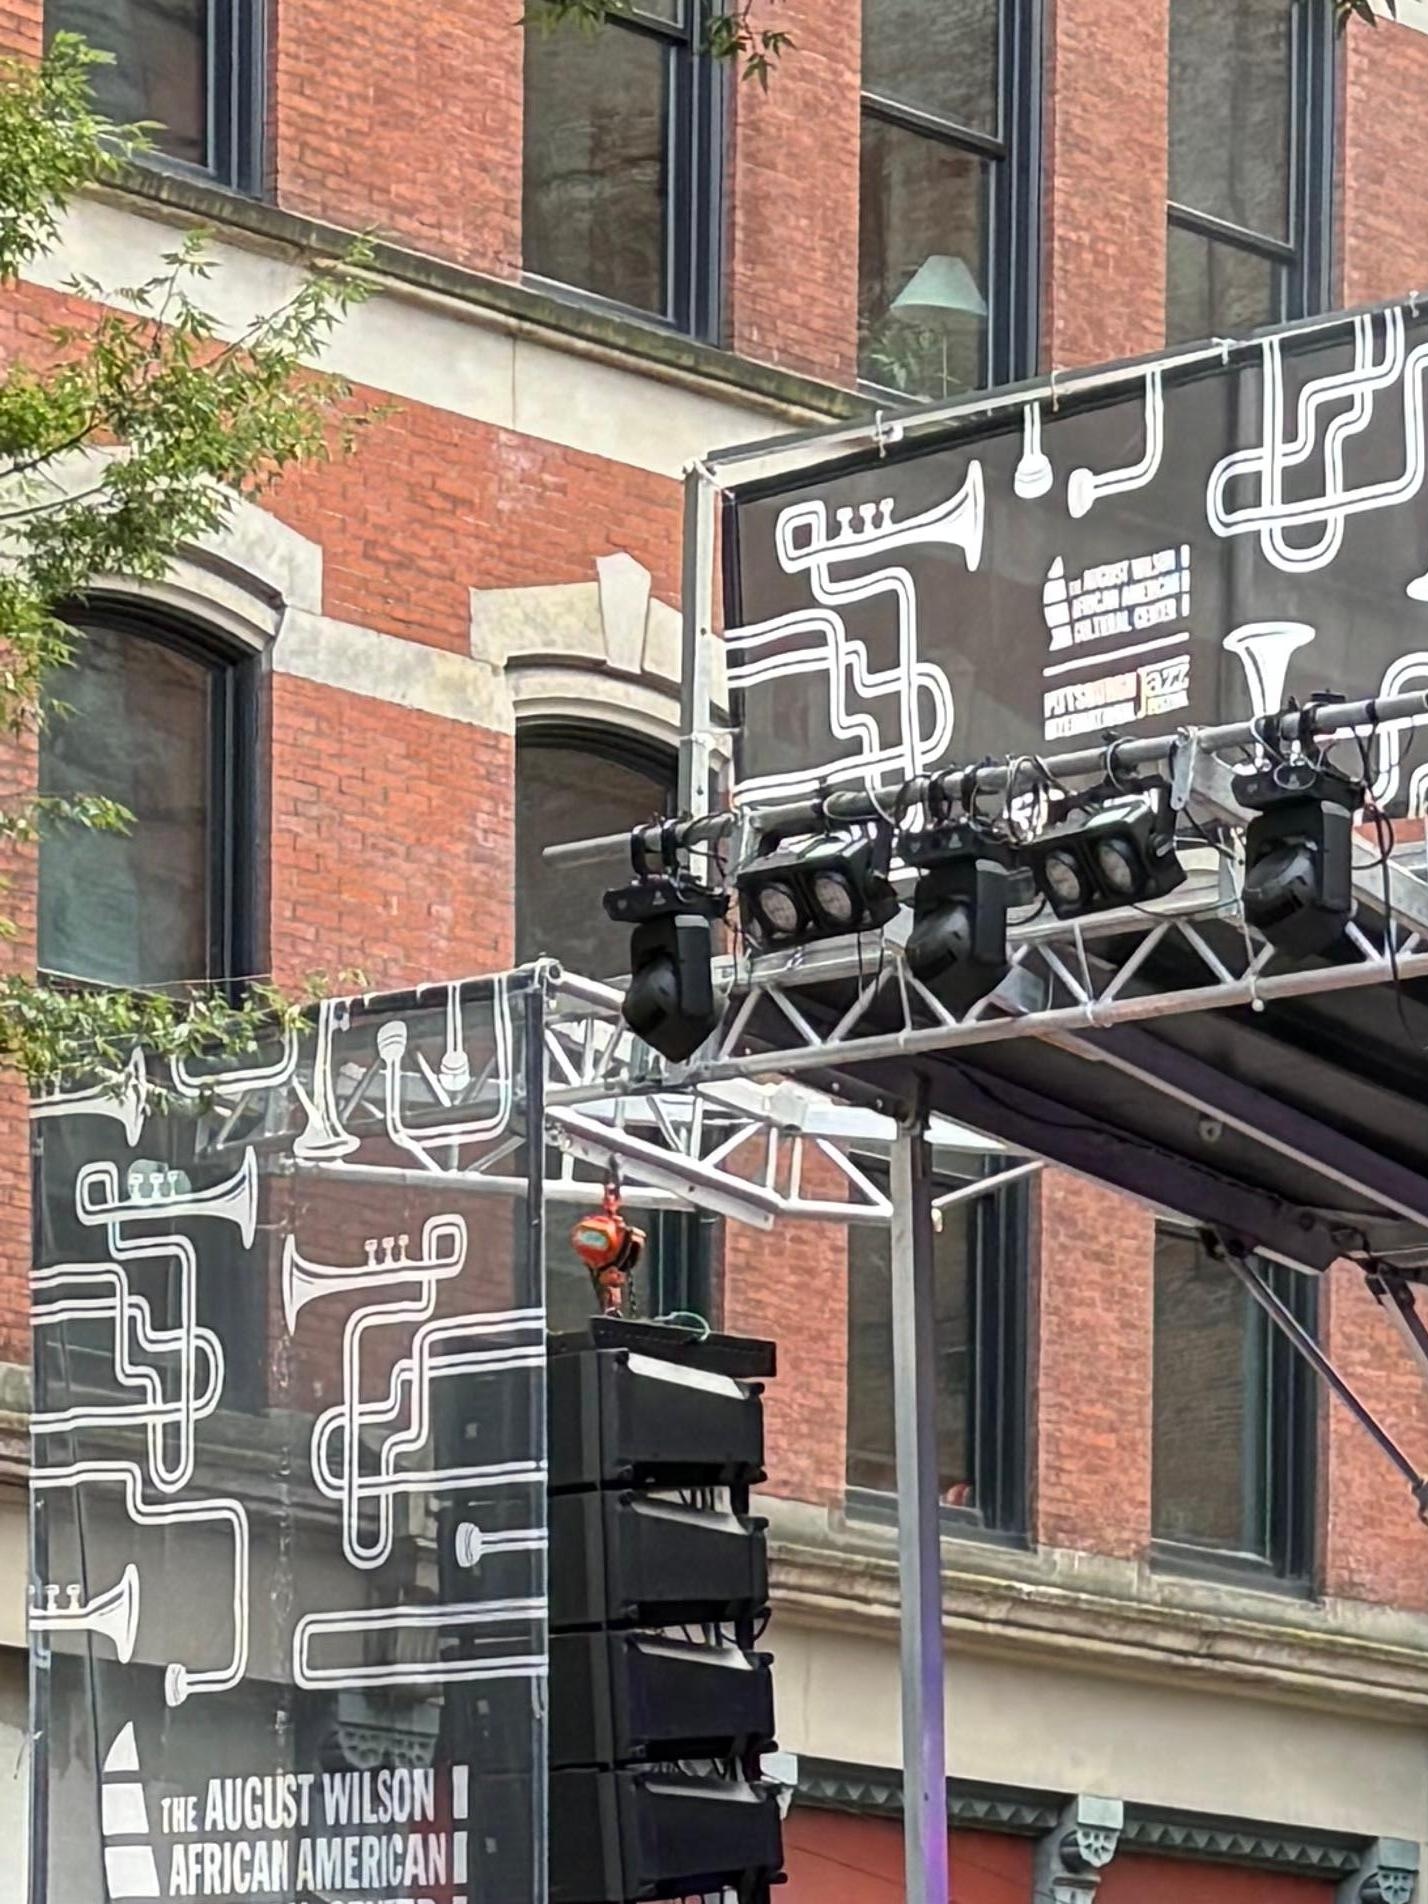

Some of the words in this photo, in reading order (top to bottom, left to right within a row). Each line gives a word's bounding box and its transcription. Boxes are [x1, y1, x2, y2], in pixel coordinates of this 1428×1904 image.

[161, 1797, 198, 1834] THE
[204, 1774, 312, 1832] AUGUST
[323, 1768, 435, 1827] WILSON
[168, 1840, 289, 1897] AFRICAN
[296, 1831, 447, 1893] AMERICAN
